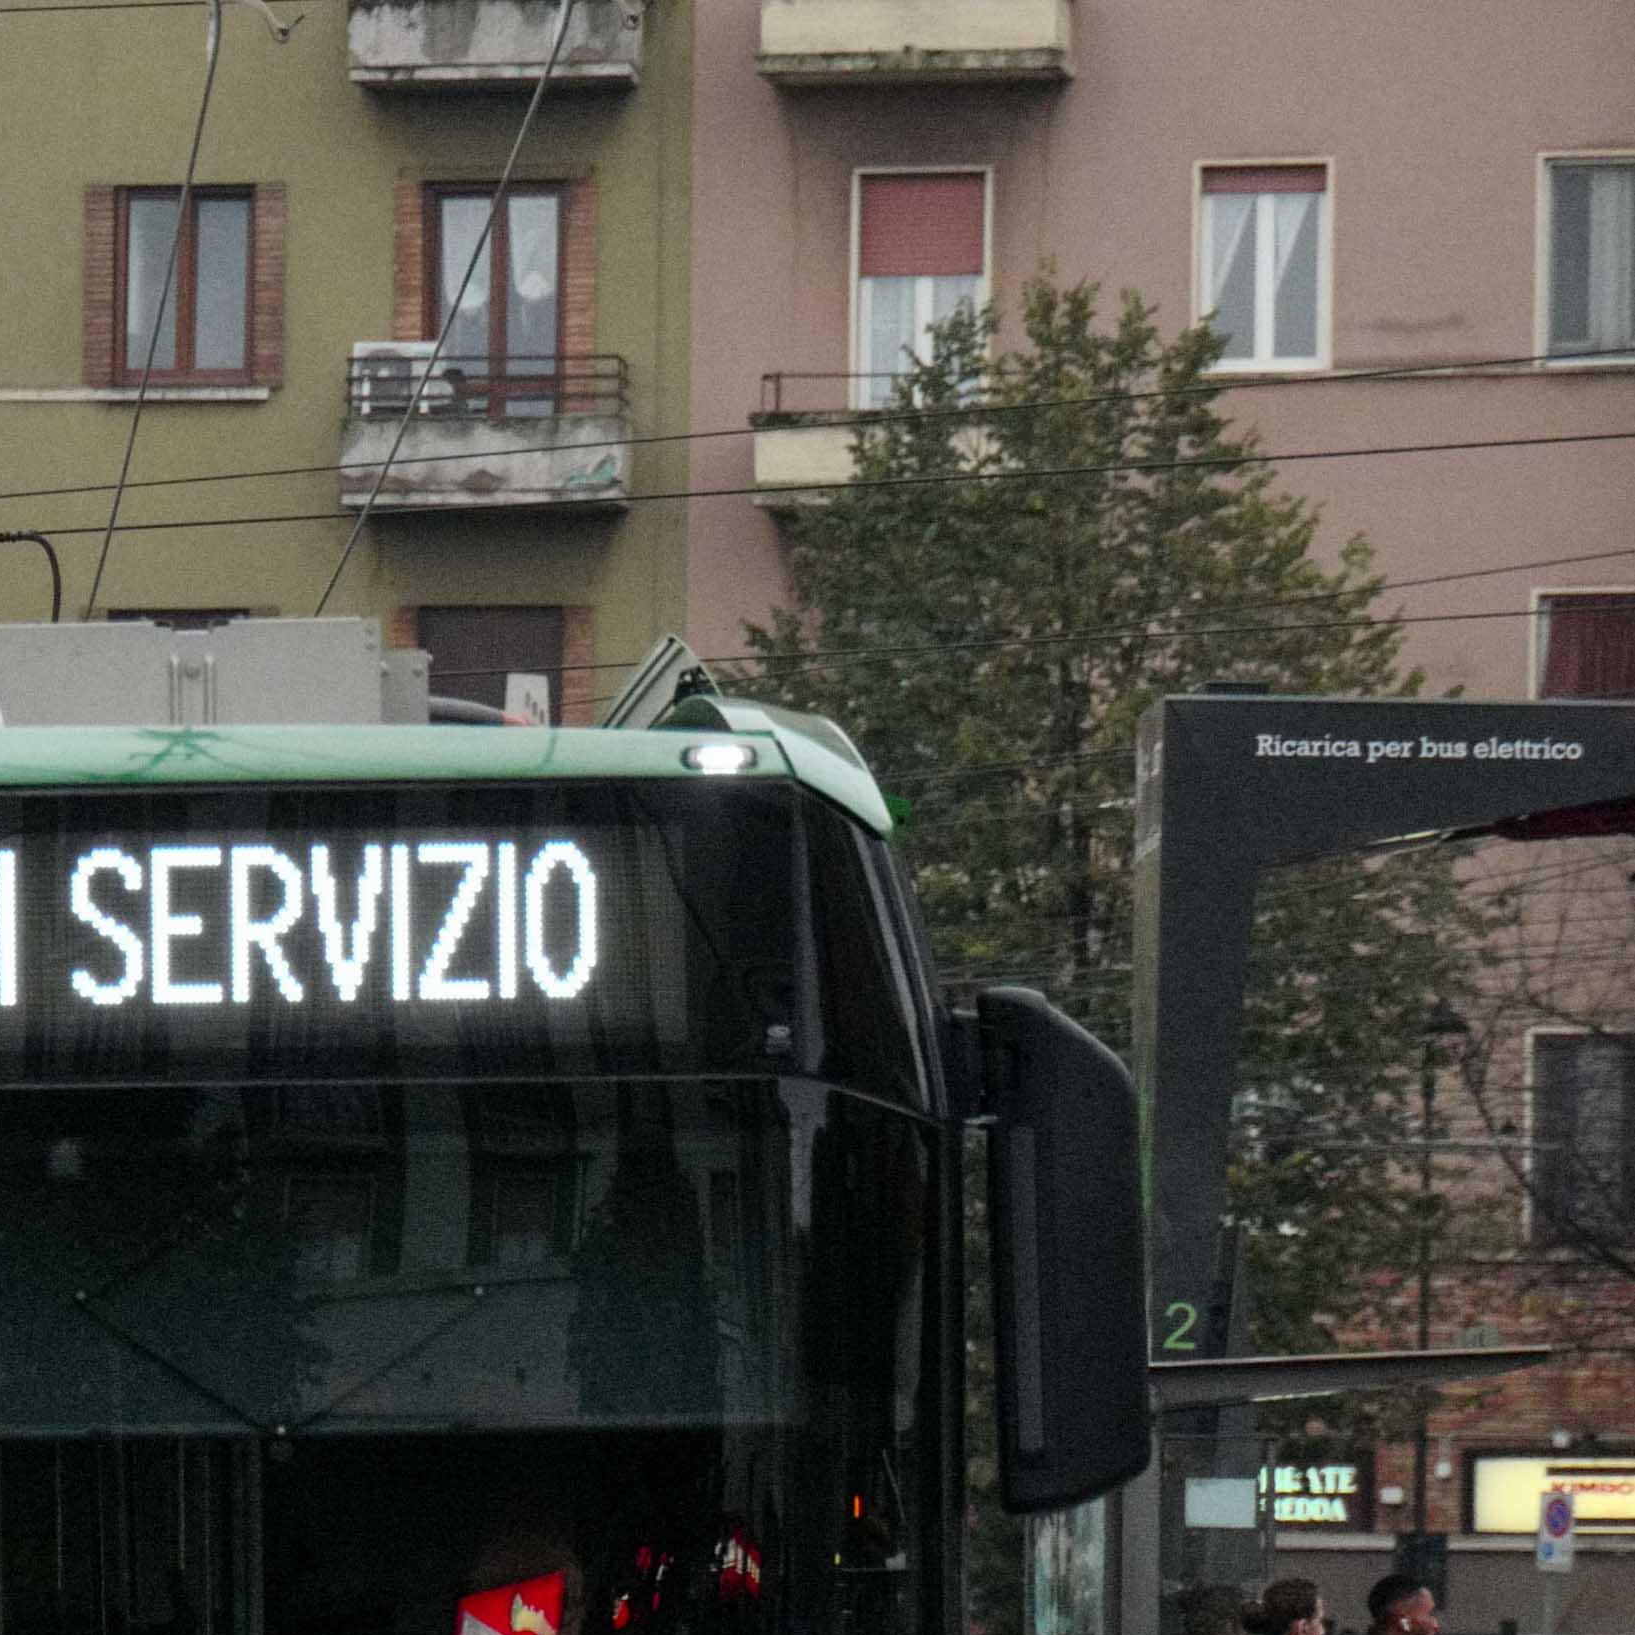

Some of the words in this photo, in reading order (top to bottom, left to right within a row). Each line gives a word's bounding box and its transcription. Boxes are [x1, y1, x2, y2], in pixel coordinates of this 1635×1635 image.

[1256, 733, 1360, 758] Ricarica
[1365, 739, 1413, 764] per
[1418, 735, 1467, 759] bus
[1472, 736, 1582, 760] elettrico
[70, 841, 598, 1005] SERVIZIO
[1162, 1301, 1198, 1350] 2
